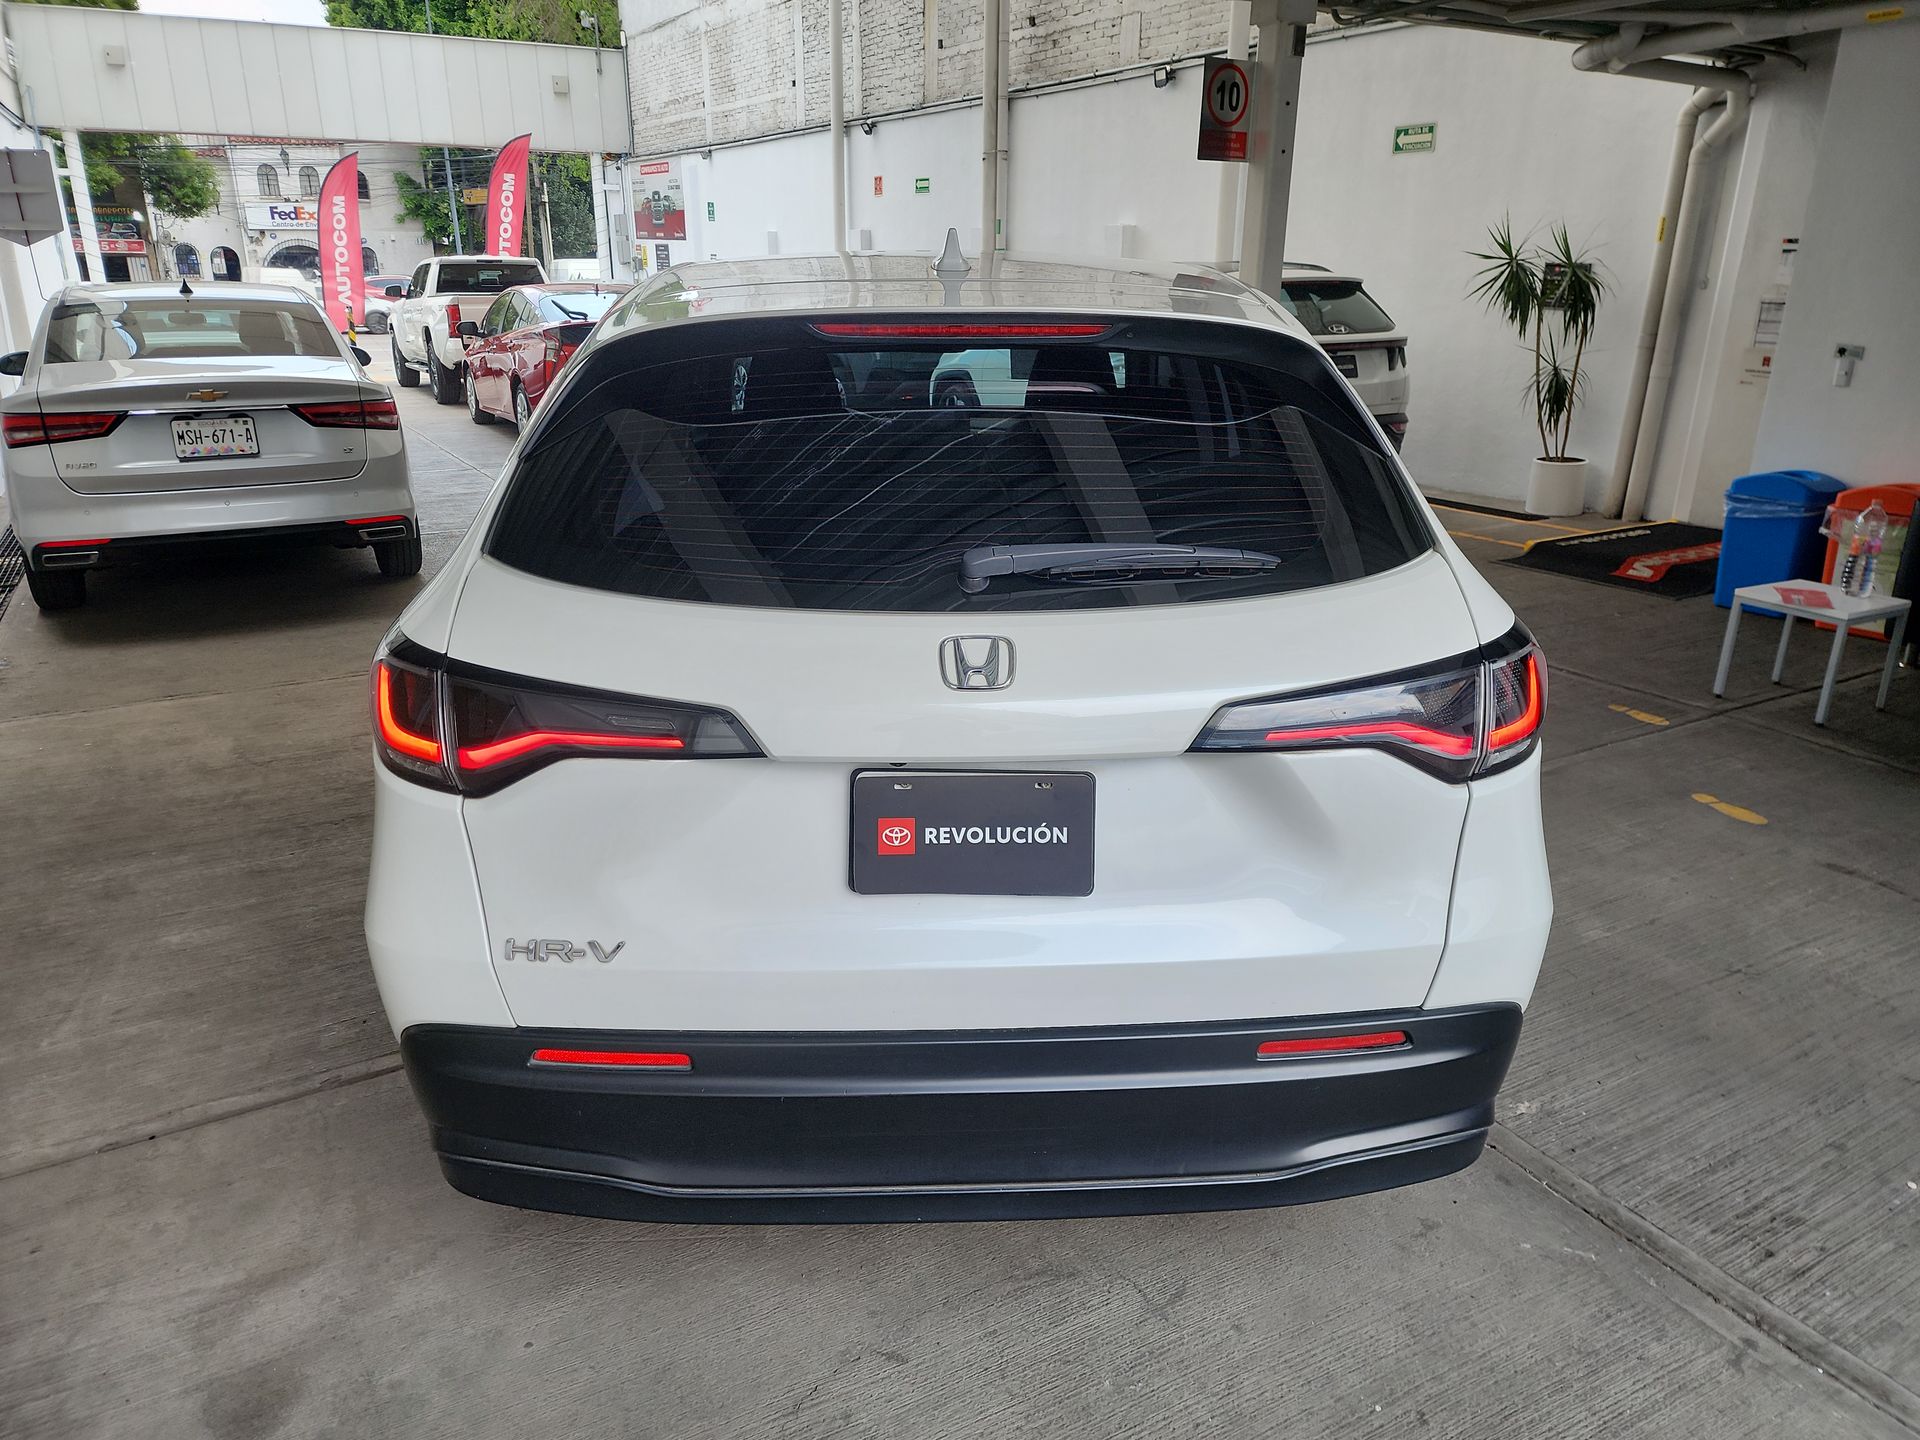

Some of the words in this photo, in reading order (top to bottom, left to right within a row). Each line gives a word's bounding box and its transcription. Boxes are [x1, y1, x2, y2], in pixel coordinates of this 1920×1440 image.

[1217, 79, 1241, 112] 10
[269, 206, 317, 221] FedEx
[271, 220, 294, 229] Centro
[331, 195, 353, 307] AUTOCOM
[177, 427, 254, 446] MSH-671-A
[924, 822, 1068, 845] REVOLUCIÓN
[504, 937, 626, 963] HR-V
